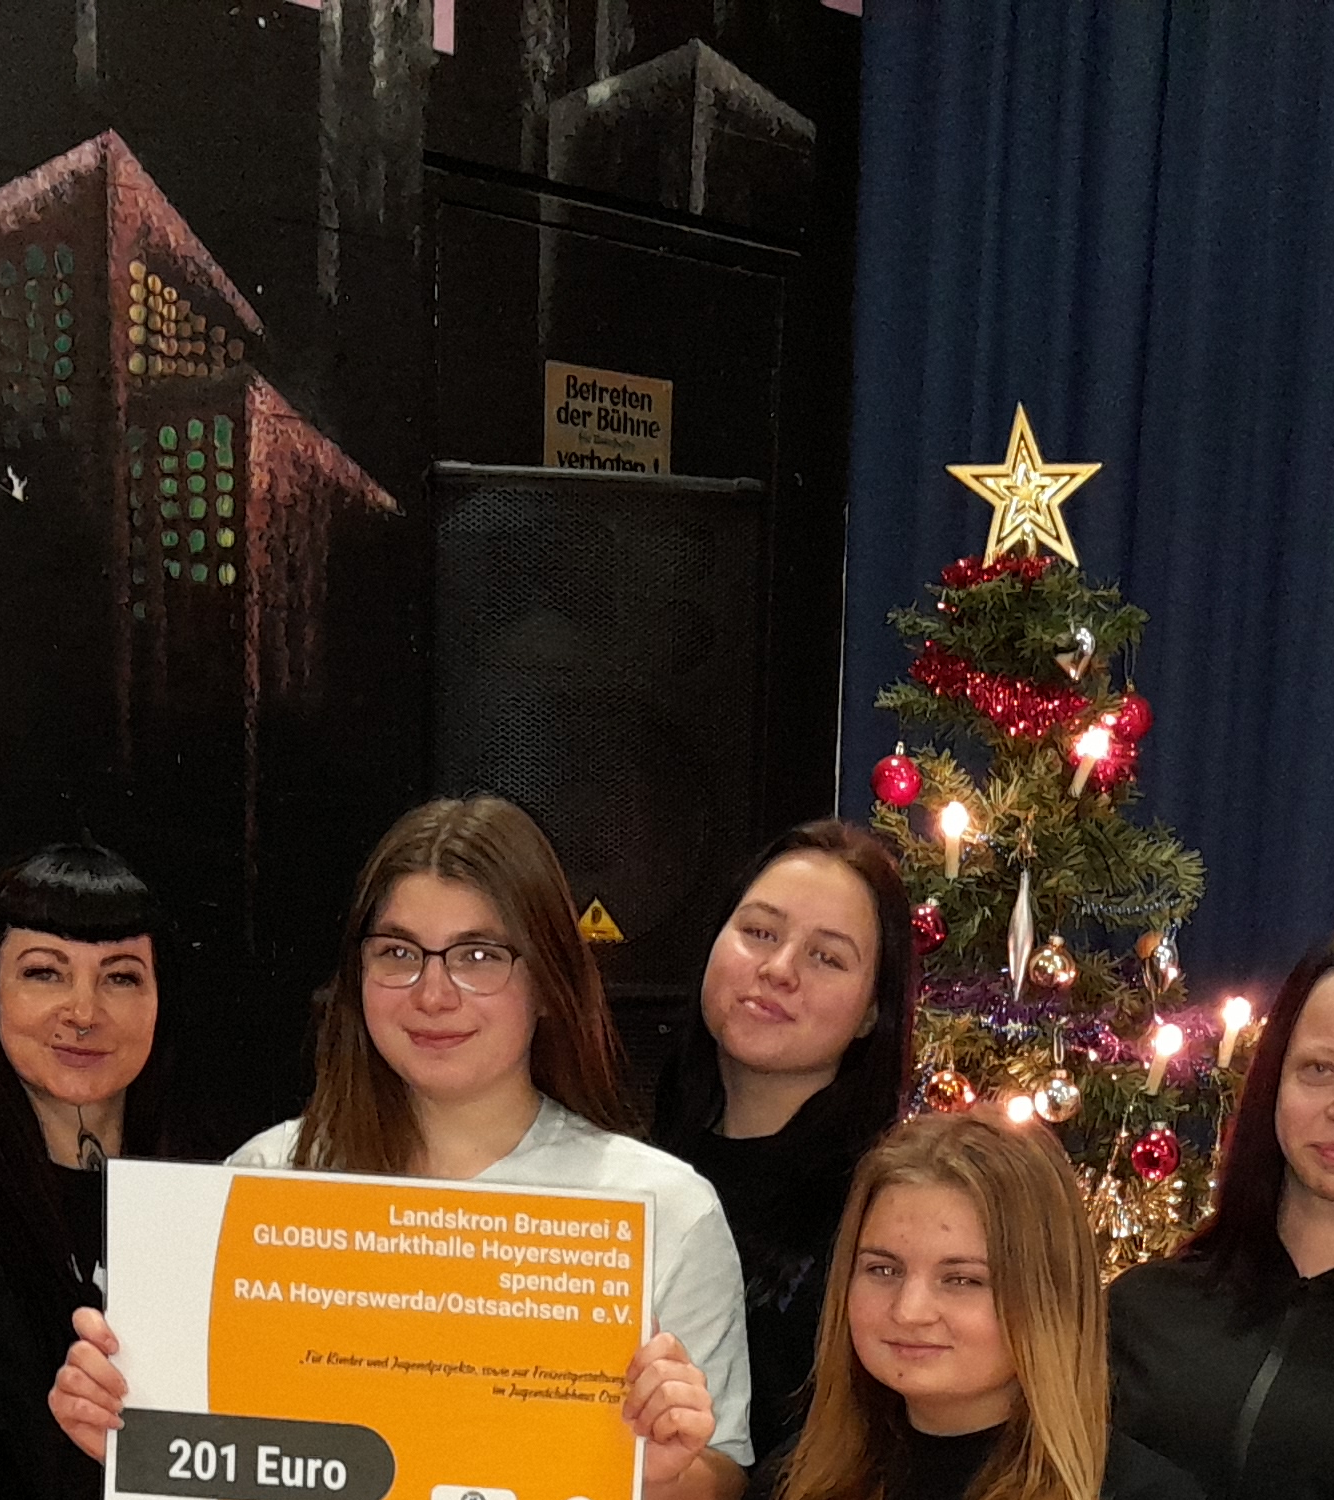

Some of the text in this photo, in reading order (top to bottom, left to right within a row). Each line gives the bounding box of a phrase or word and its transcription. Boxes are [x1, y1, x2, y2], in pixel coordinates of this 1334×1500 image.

[566, 374, 652, 413] Betreten
[556, 401, 662, 438] der Bühne
[389, 1204, 632, 1241] Landskron Brauerei &
[253, 1223, 630, 1269] GLOBUS Markthalle Hoyerswerda
[234, 1278, 633, 1325] RAA Hoyerswerda/Ostsachsen e.V.
[498, 1271, 629, 1297] spenden an
[367, 1356, 389, 1368] und
[168, 1438, 348, 1491] 201 Euro
